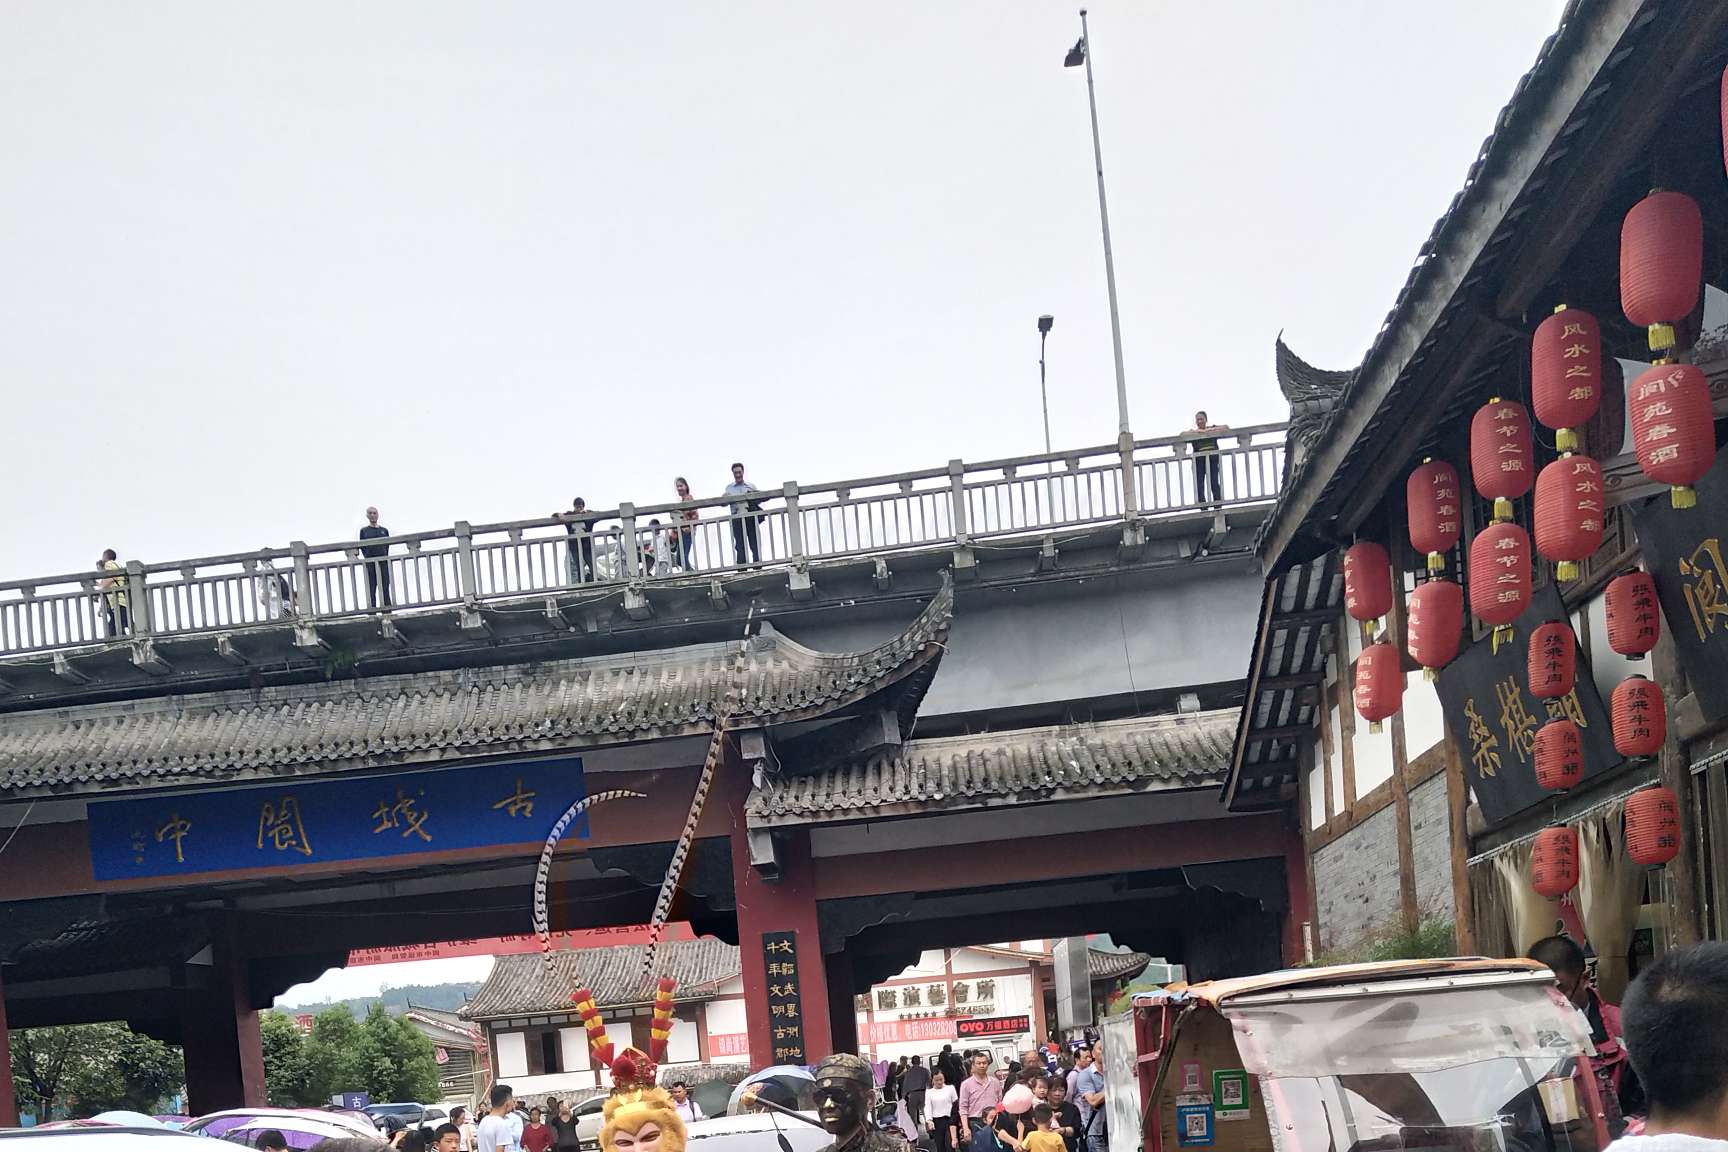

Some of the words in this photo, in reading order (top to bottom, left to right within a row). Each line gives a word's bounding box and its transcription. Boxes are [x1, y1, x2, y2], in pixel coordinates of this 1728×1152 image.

[1561, 323, 1593, 400] 风水之都
[1494, 408, 1525, 472] 春节之源
[1572, 463, 1601, 532] 风水之都
[1495, 537, 1521, 603] 春节之源
